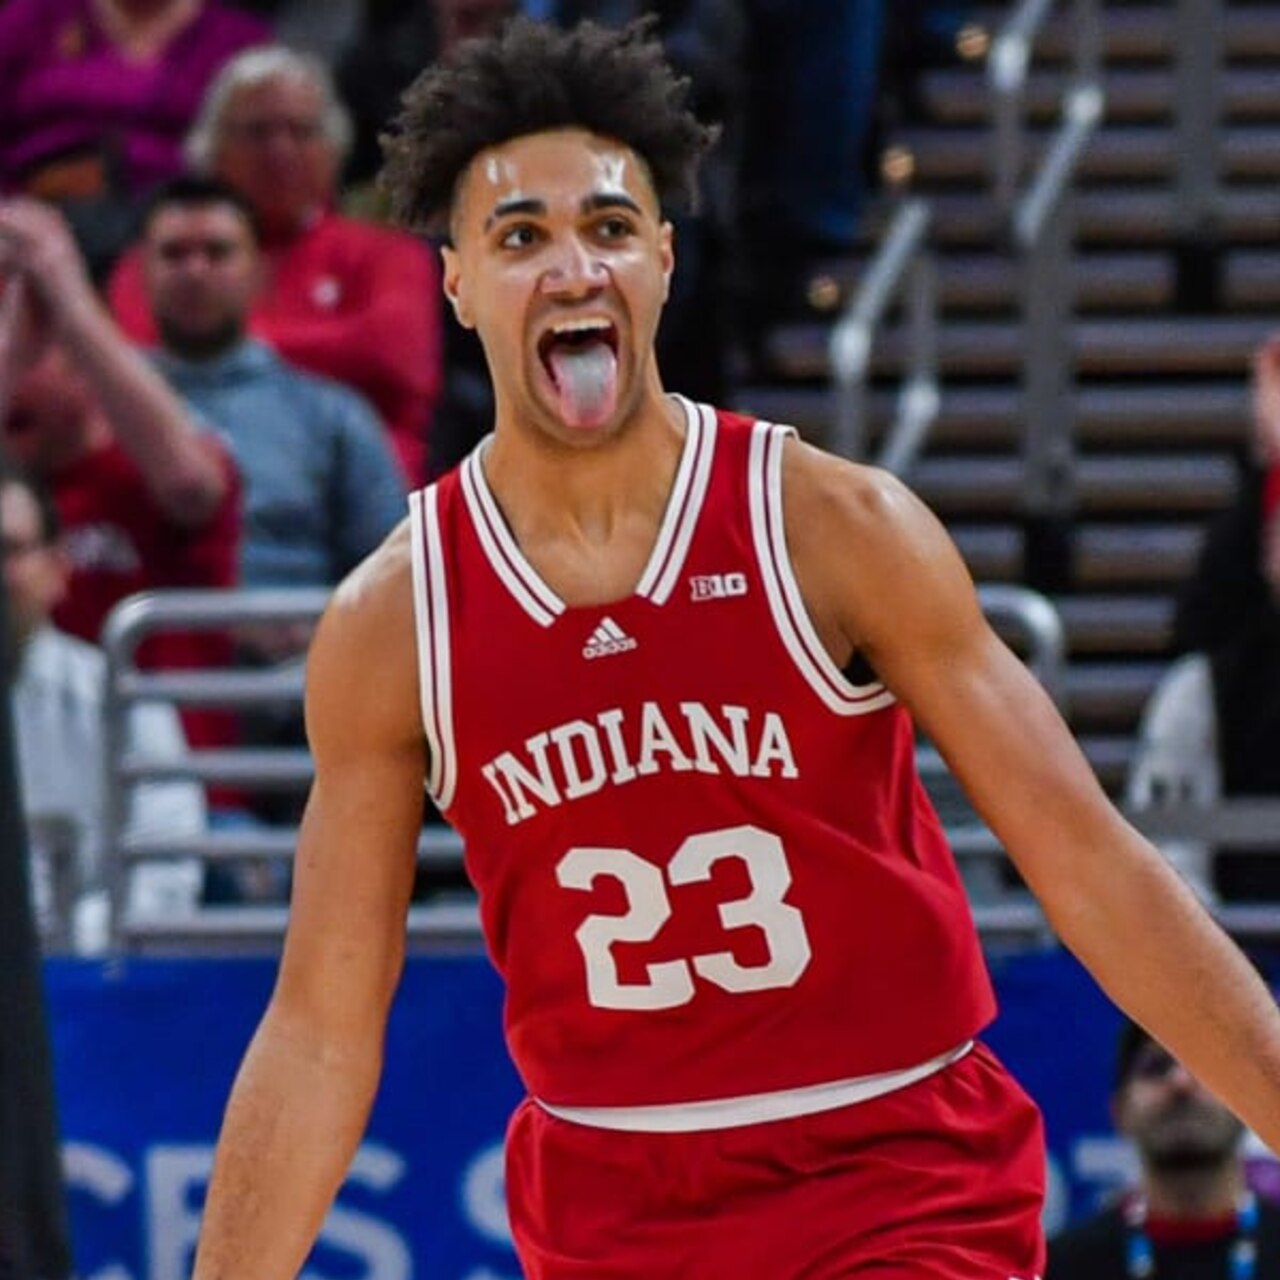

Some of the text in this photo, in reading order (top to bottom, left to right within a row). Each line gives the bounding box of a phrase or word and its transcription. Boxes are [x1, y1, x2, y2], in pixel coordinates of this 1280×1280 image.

[582, 637, 638, 660] adidas
[482, 702, 799, 825] INDIANA
[554, 824, 812, 1011] 23
